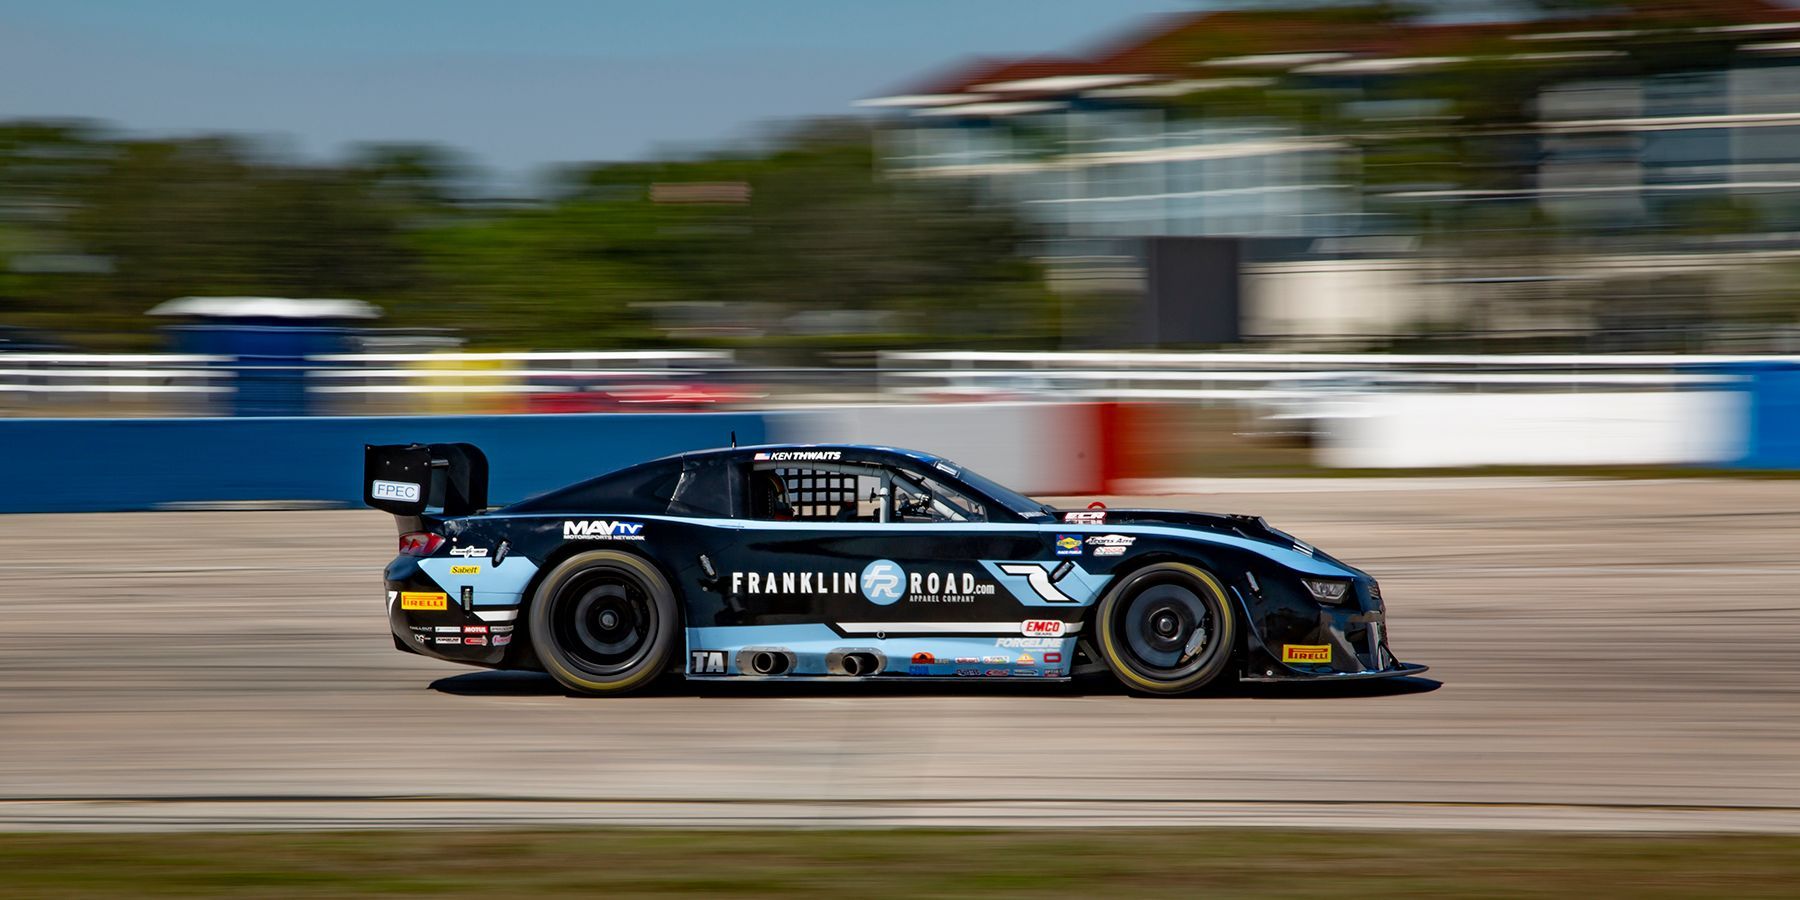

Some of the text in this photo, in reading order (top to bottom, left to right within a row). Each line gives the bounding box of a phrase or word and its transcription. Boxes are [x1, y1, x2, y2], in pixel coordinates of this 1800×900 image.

[771, 451, 841, 460] KEN THWAITS
[377, 484, 416, 499] FPEC
[452, 566, 478, 574] Sabelt
[732, 572, 857, 594] FRANKLIN
[403, 595, 444, 607] PIRELLI
[1026, 621, 1060, 632] EMCO
[995, 638, 1063, 648] FORGELINE
[1288, 648, 1328, 660] PIRELLI
[692, 652, 724, 673] TA
